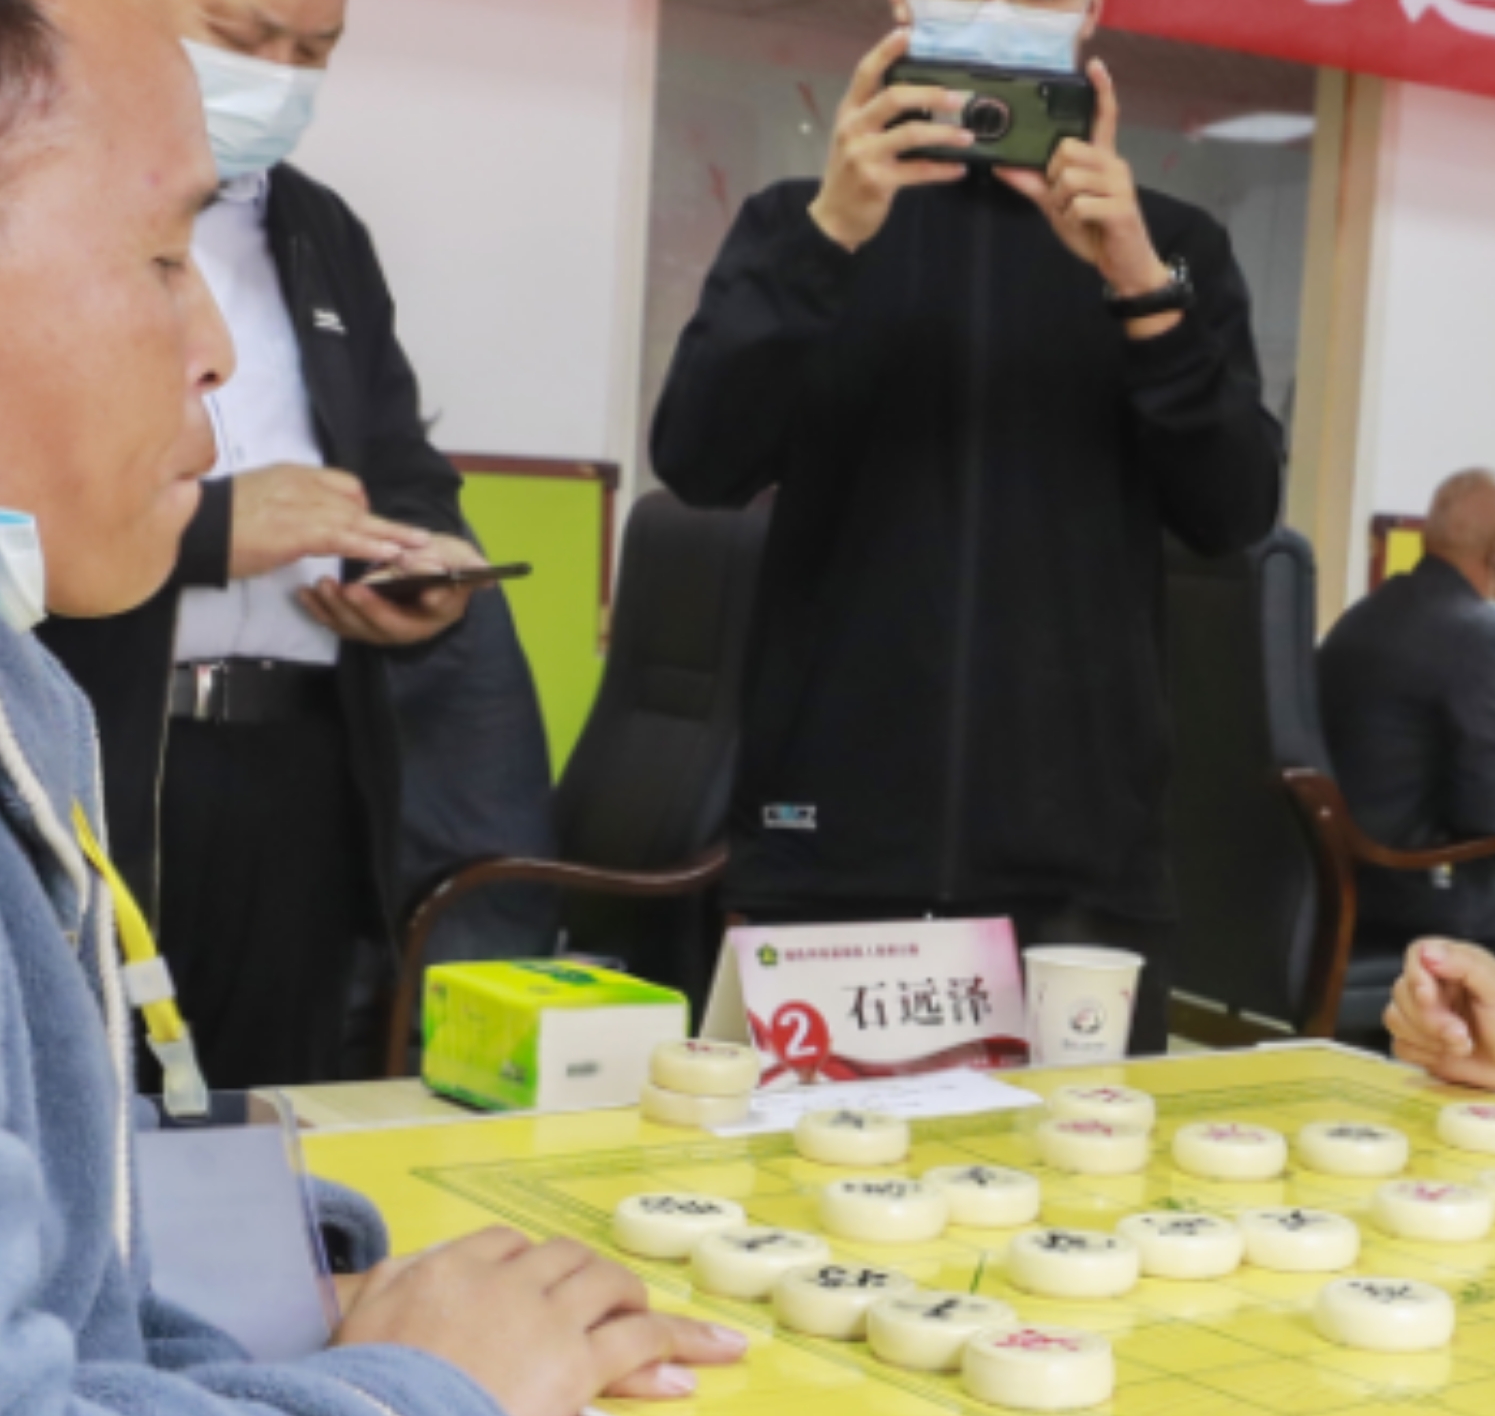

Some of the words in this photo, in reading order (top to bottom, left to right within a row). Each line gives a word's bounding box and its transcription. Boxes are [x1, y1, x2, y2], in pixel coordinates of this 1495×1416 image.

[844, 973, 994, 1032] 石远泽
[779, 1006, 819, 1060] 2
